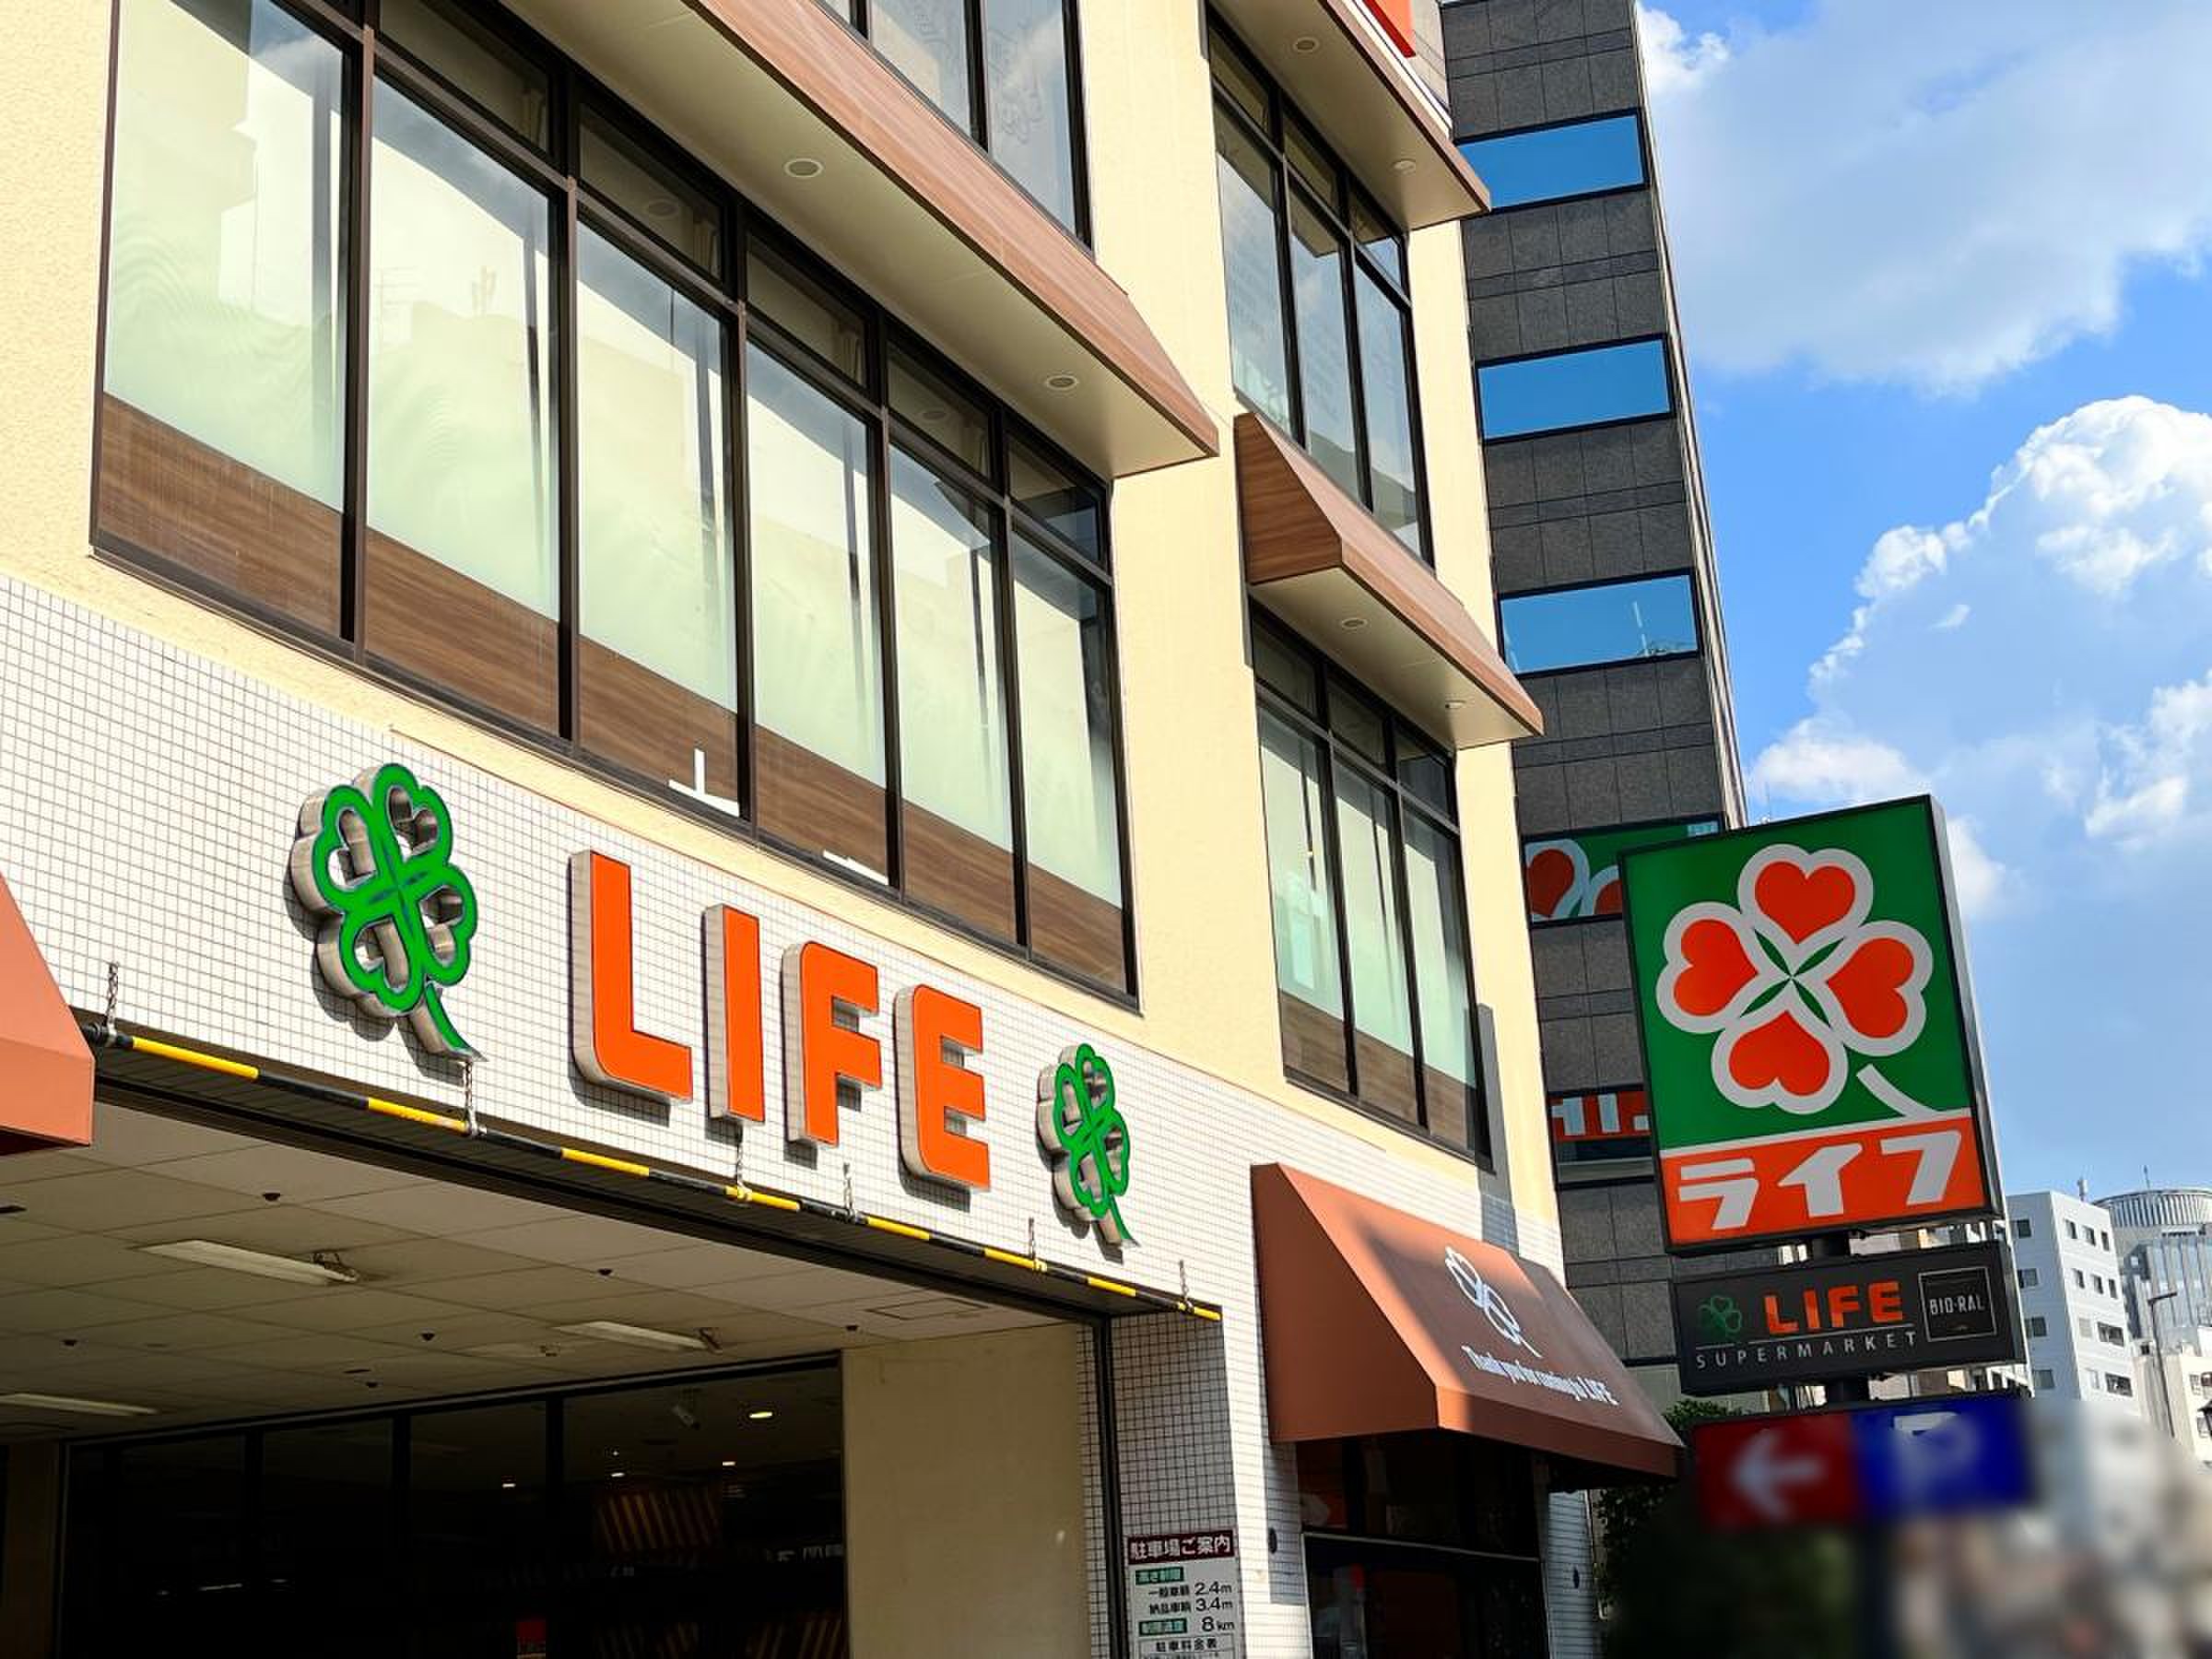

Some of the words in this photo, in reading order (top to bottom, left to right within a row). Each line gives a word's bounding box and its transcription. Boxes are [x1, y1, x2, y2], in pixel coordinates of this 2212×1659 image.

[572, 850, 990, 1191] LIFE
[1677, 1128, 1961, 1230] ライフ
[1762, 1280, 1904, 1335] LIFE
[1695, 1331, 1917, 1370] SUPERMARKET
[1130, 1535, 1231, 1560] 駐車場ご案内
[1194, 1581, 1232, 1596] 2.4m
[1195, 1597, 1233, 1612] 3.4m
